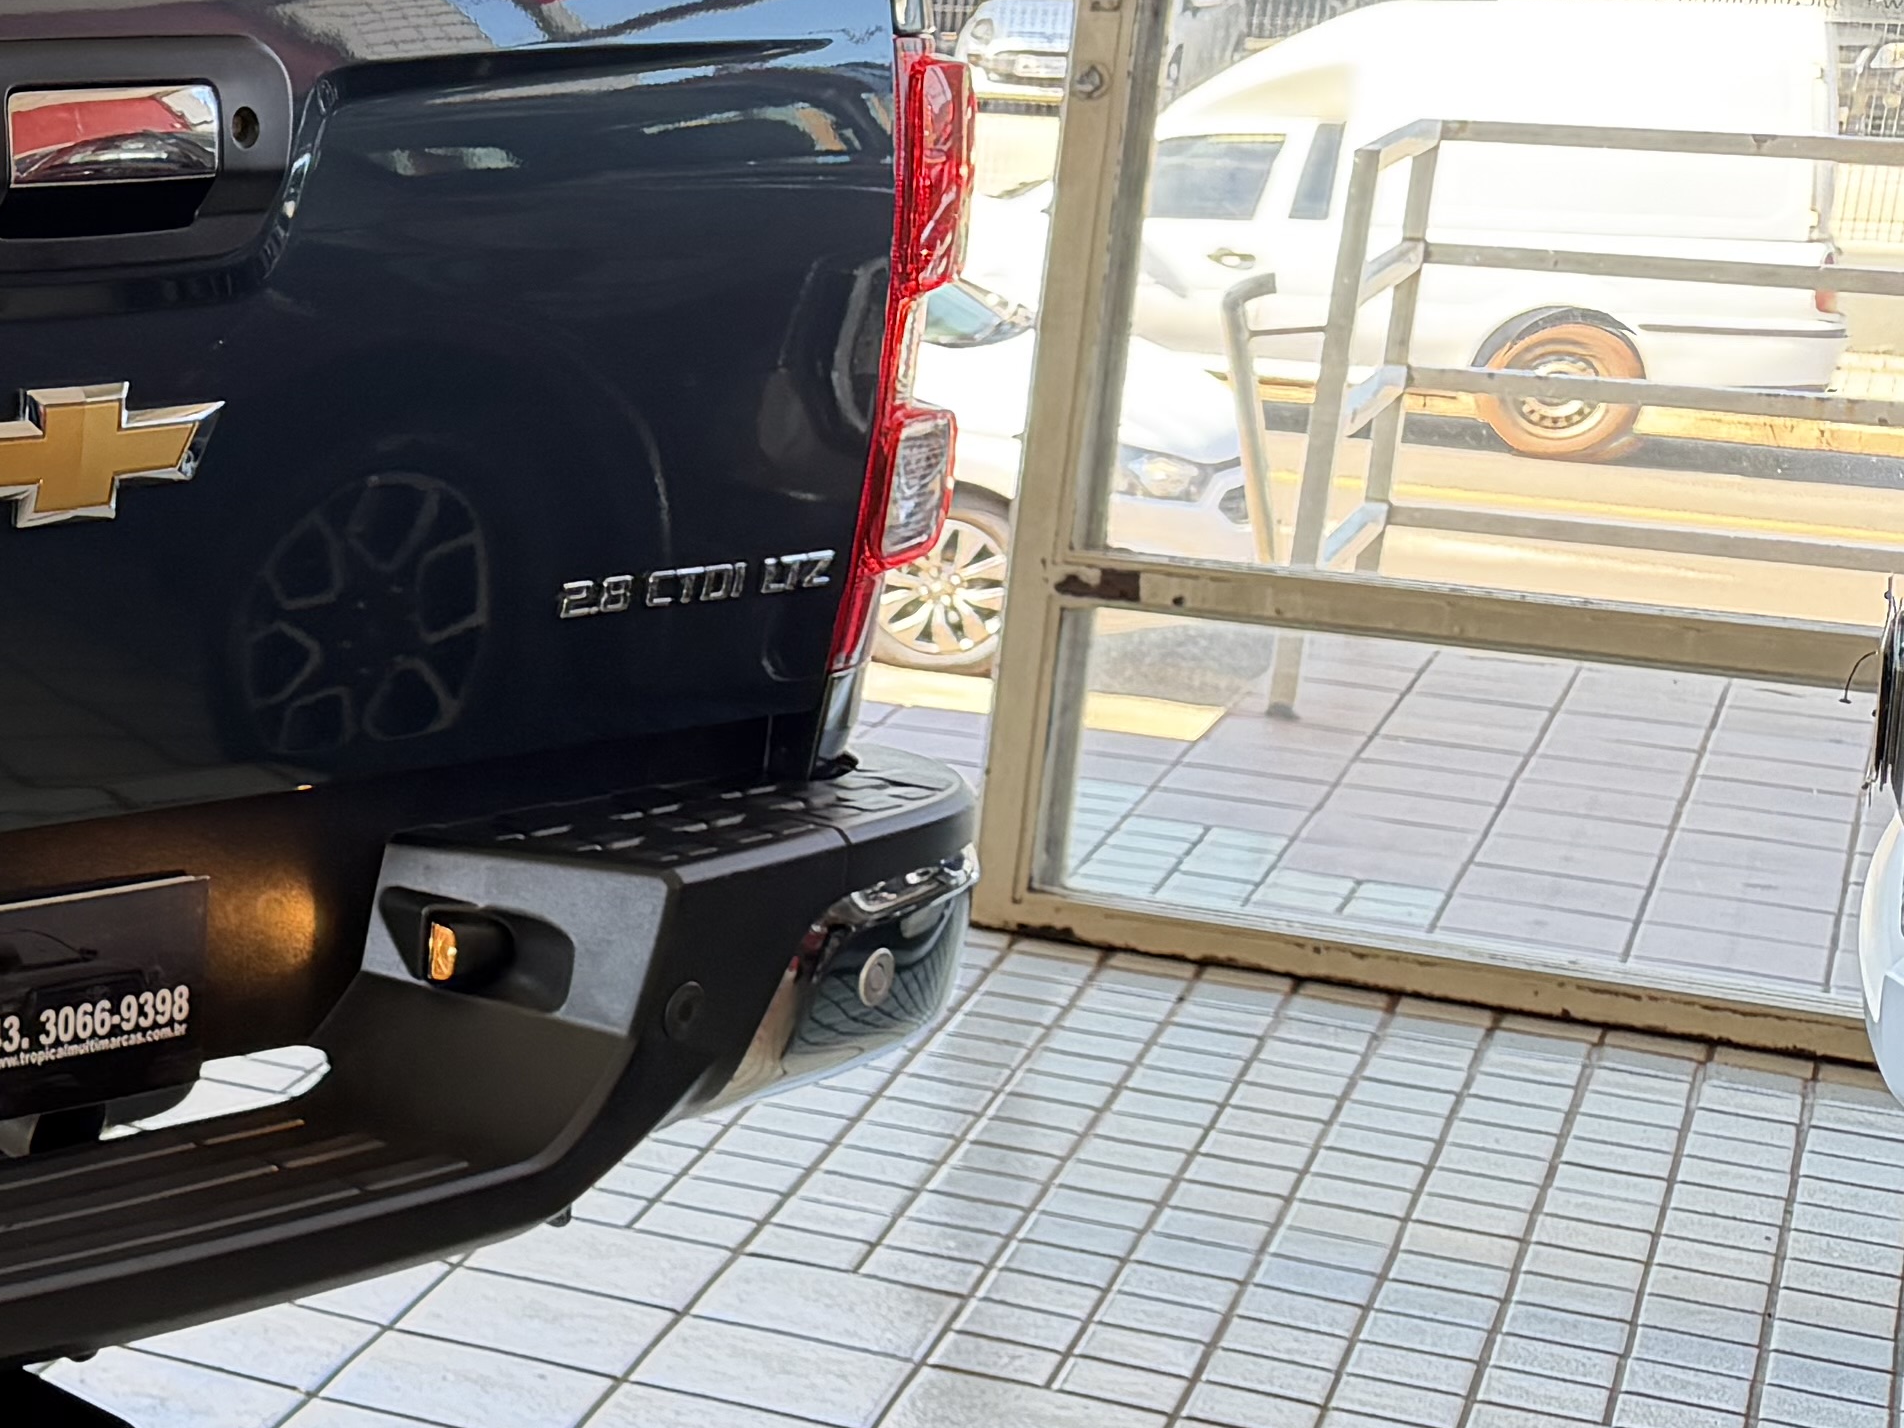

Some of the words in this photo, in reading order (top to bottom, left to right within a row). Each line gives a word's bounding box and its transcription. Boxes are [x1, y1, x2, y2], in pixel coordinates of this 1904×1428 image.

[560, 575, 634, 619] 2.8
[646, 562, 747, 607] CTDI
[761, 549, 835, 594] LTZ
[39, 985, 190, 1044] 3066-9398
